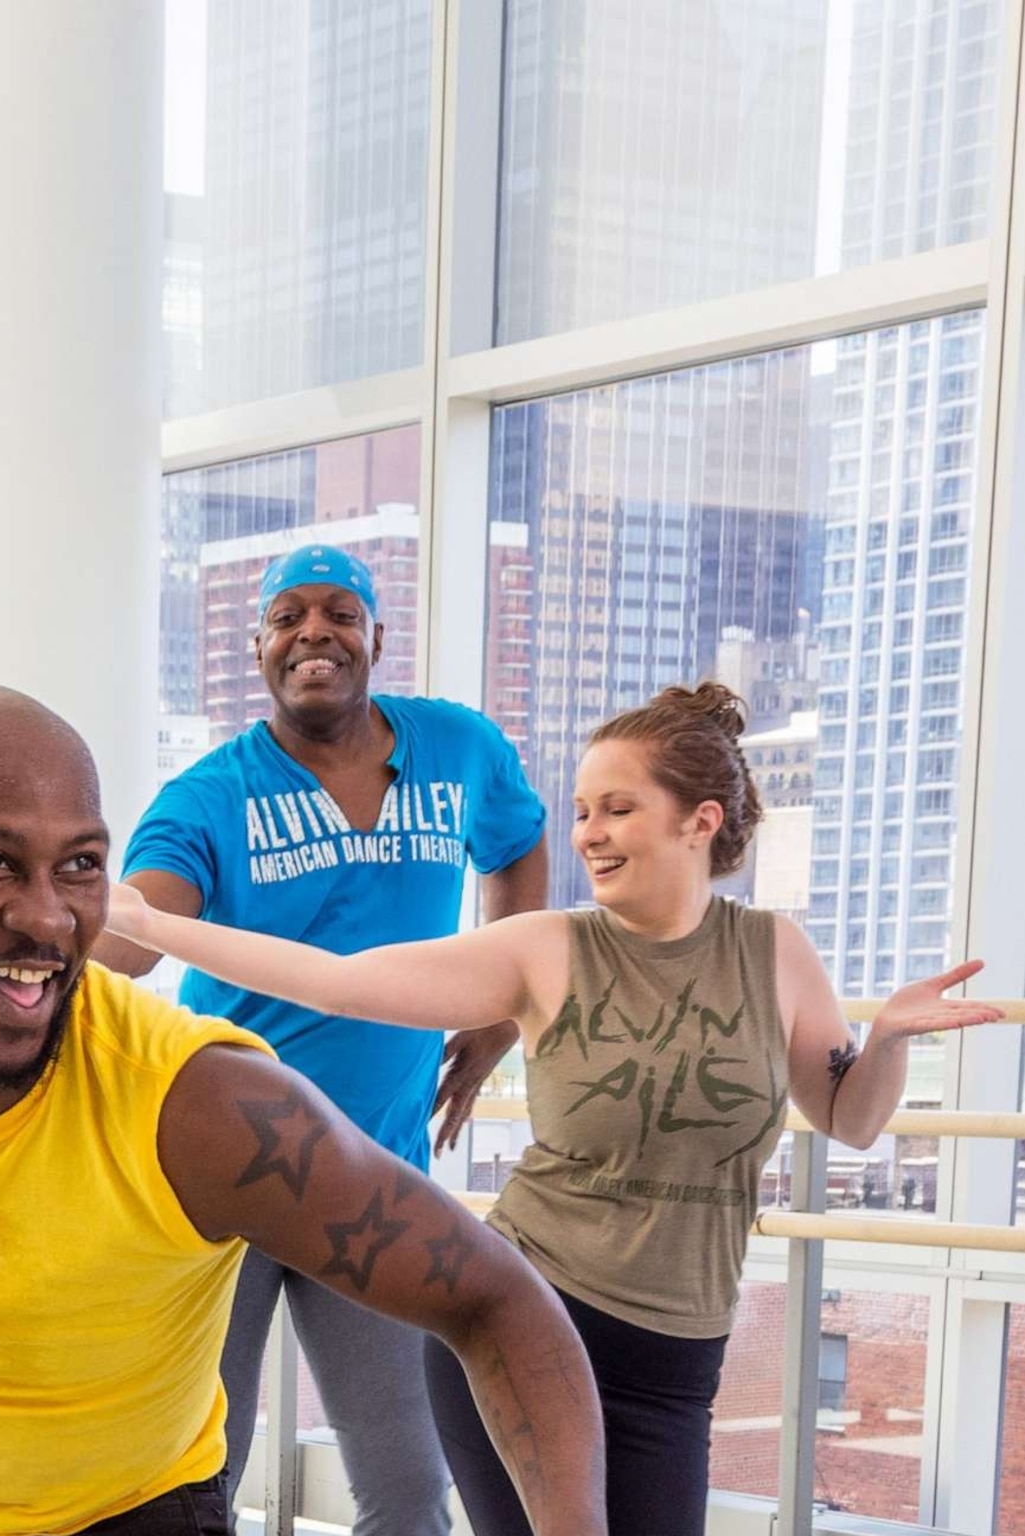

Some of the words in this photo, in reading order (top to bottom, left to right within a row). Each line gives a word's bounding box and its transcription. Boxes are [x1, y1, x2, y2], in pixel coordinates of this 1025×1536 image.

[245, 787, 351, 851] ALVIN
[376, 781, 464, 835] AILEY
[250, 840, 338, 885] AMERICAN
[342, 834, 402, 864] DANCE
[409, 834, 464, 868] THEATE
[536, 976, 746, 1060] ALVIN
